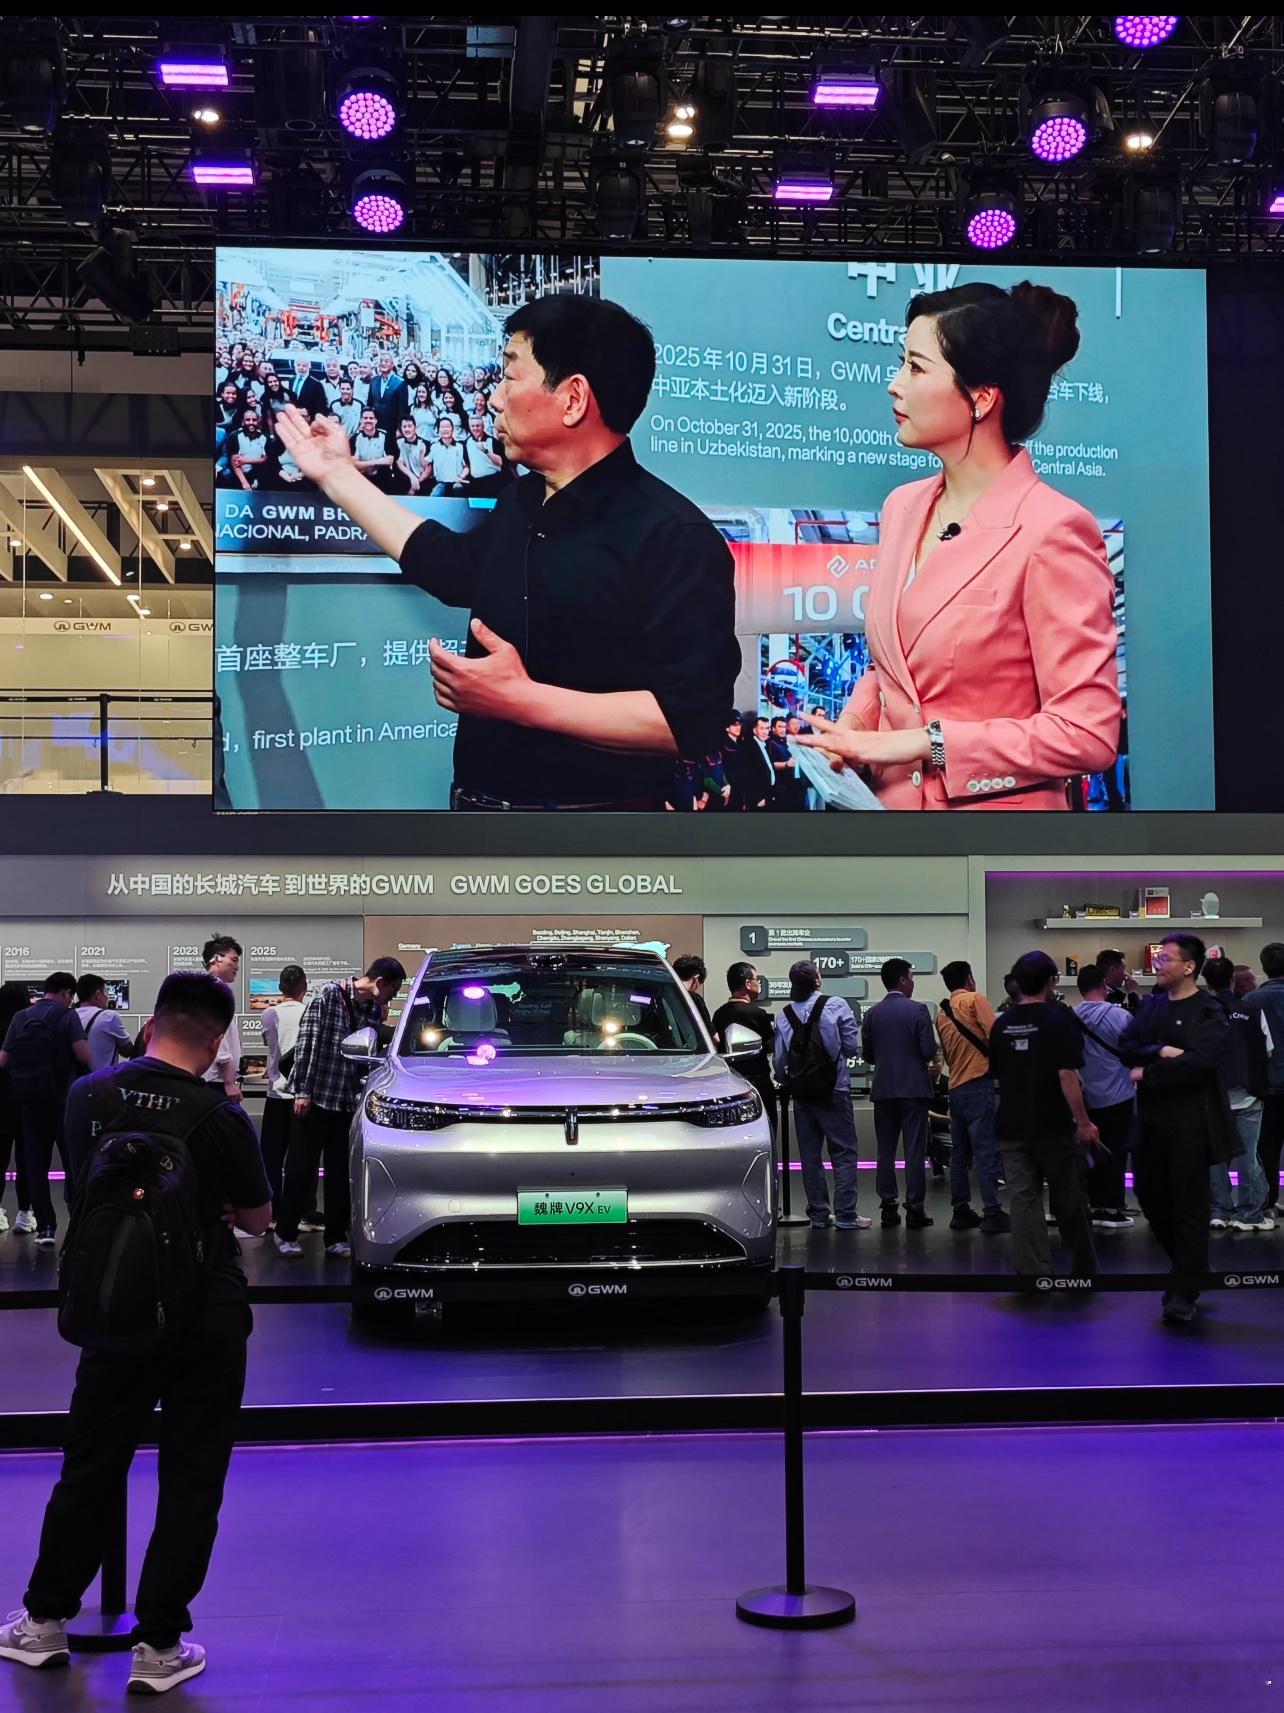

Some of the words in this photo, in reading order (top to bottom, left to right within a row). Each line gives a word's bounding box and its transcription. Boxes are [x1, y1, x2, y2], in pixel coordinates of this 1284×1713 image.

[651, 375, 847, 411] 中亚本土化迈入新阶段。
[650, 415, 675, 432] On
[677, 416, 740, 436] October
[742, 421, 763, 441] 31,
[765, 423, 806, 443] 2025,
[808, 426, 832, 441] the
[833, 427, 892, 446] 10,000th
[1035, 441, 1054, 456] the
[1056, 443, 1118, 460] production
[650, 436, 678, 453] line
[681, 437, 694, 453] in
[697, 438, 785, 462] Uzbekistan,
[788, 447, 845, 466] marking
[847, 451, 856, 463] a
[859, 452, 887, 464] new
[889, 452, 926, 469] stage
[929, 453, 944, 468] fo
[1032, 459, 1075, 475] Central
[1077, 461, 1106, 476] Asia.
[225, 504, 253, 519] DA
[262, 505, 315, 520] GWM
[73, 622, 112, 631] GWM
[253, 730, 295, 750] first
[299, 726, 352, 753] plant
[356, 724, 374, 743] in
[107, 873, 281, 896] 从中国的长城汽车
[284, 873, 434, 896] 到世界的GWM
[450, 875, 510, 894] GWM
[515, 874, 581, 894] GOES
[586, 874, 682, 894] GLOBAL
[749, 932, 756, 944] 1
[4, 946, 30, 956] 2016
[81, 946, 105, 956] 2021
[173, 946, 199, 956] 2023
[250, 946, 277, 956] 2025
[813, 957, 844, 969] 170+
[242, 1020, 263, 1030] 202
[855, 1277, 892, 1287] GWM
[1054, 1278, 1091, 1288] GWM
[1241, 1274, 1279, 1284] GWM
[394, 1289, 433, 1298] GWM
[588, 1284, 627, 1294] GWM
